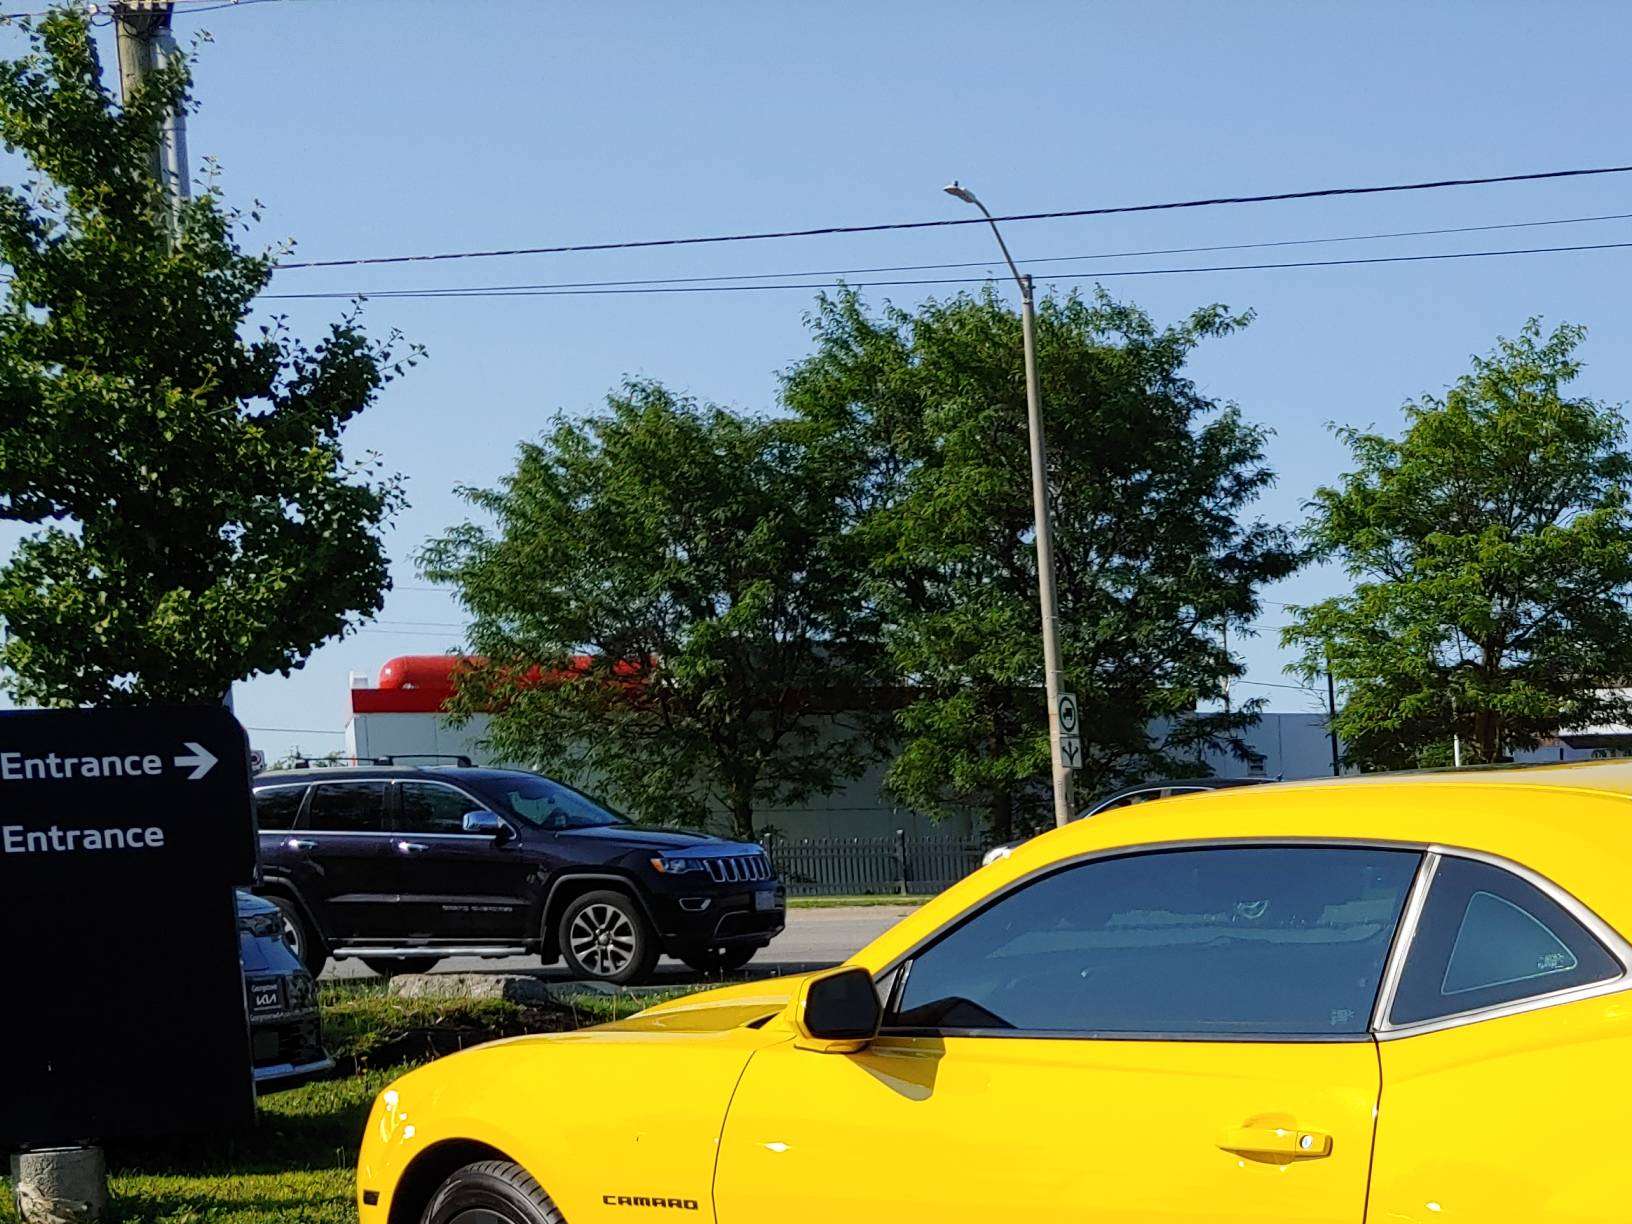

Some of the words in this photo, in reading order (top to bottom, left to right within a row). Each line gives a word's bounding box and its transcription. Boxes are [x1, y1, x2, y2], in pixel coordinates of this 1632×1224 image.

[1, 752, 163, 780] Entrance
[2, 825, 165, 853] Entrance
[602, 1194, 698, 1211] CAMARO
